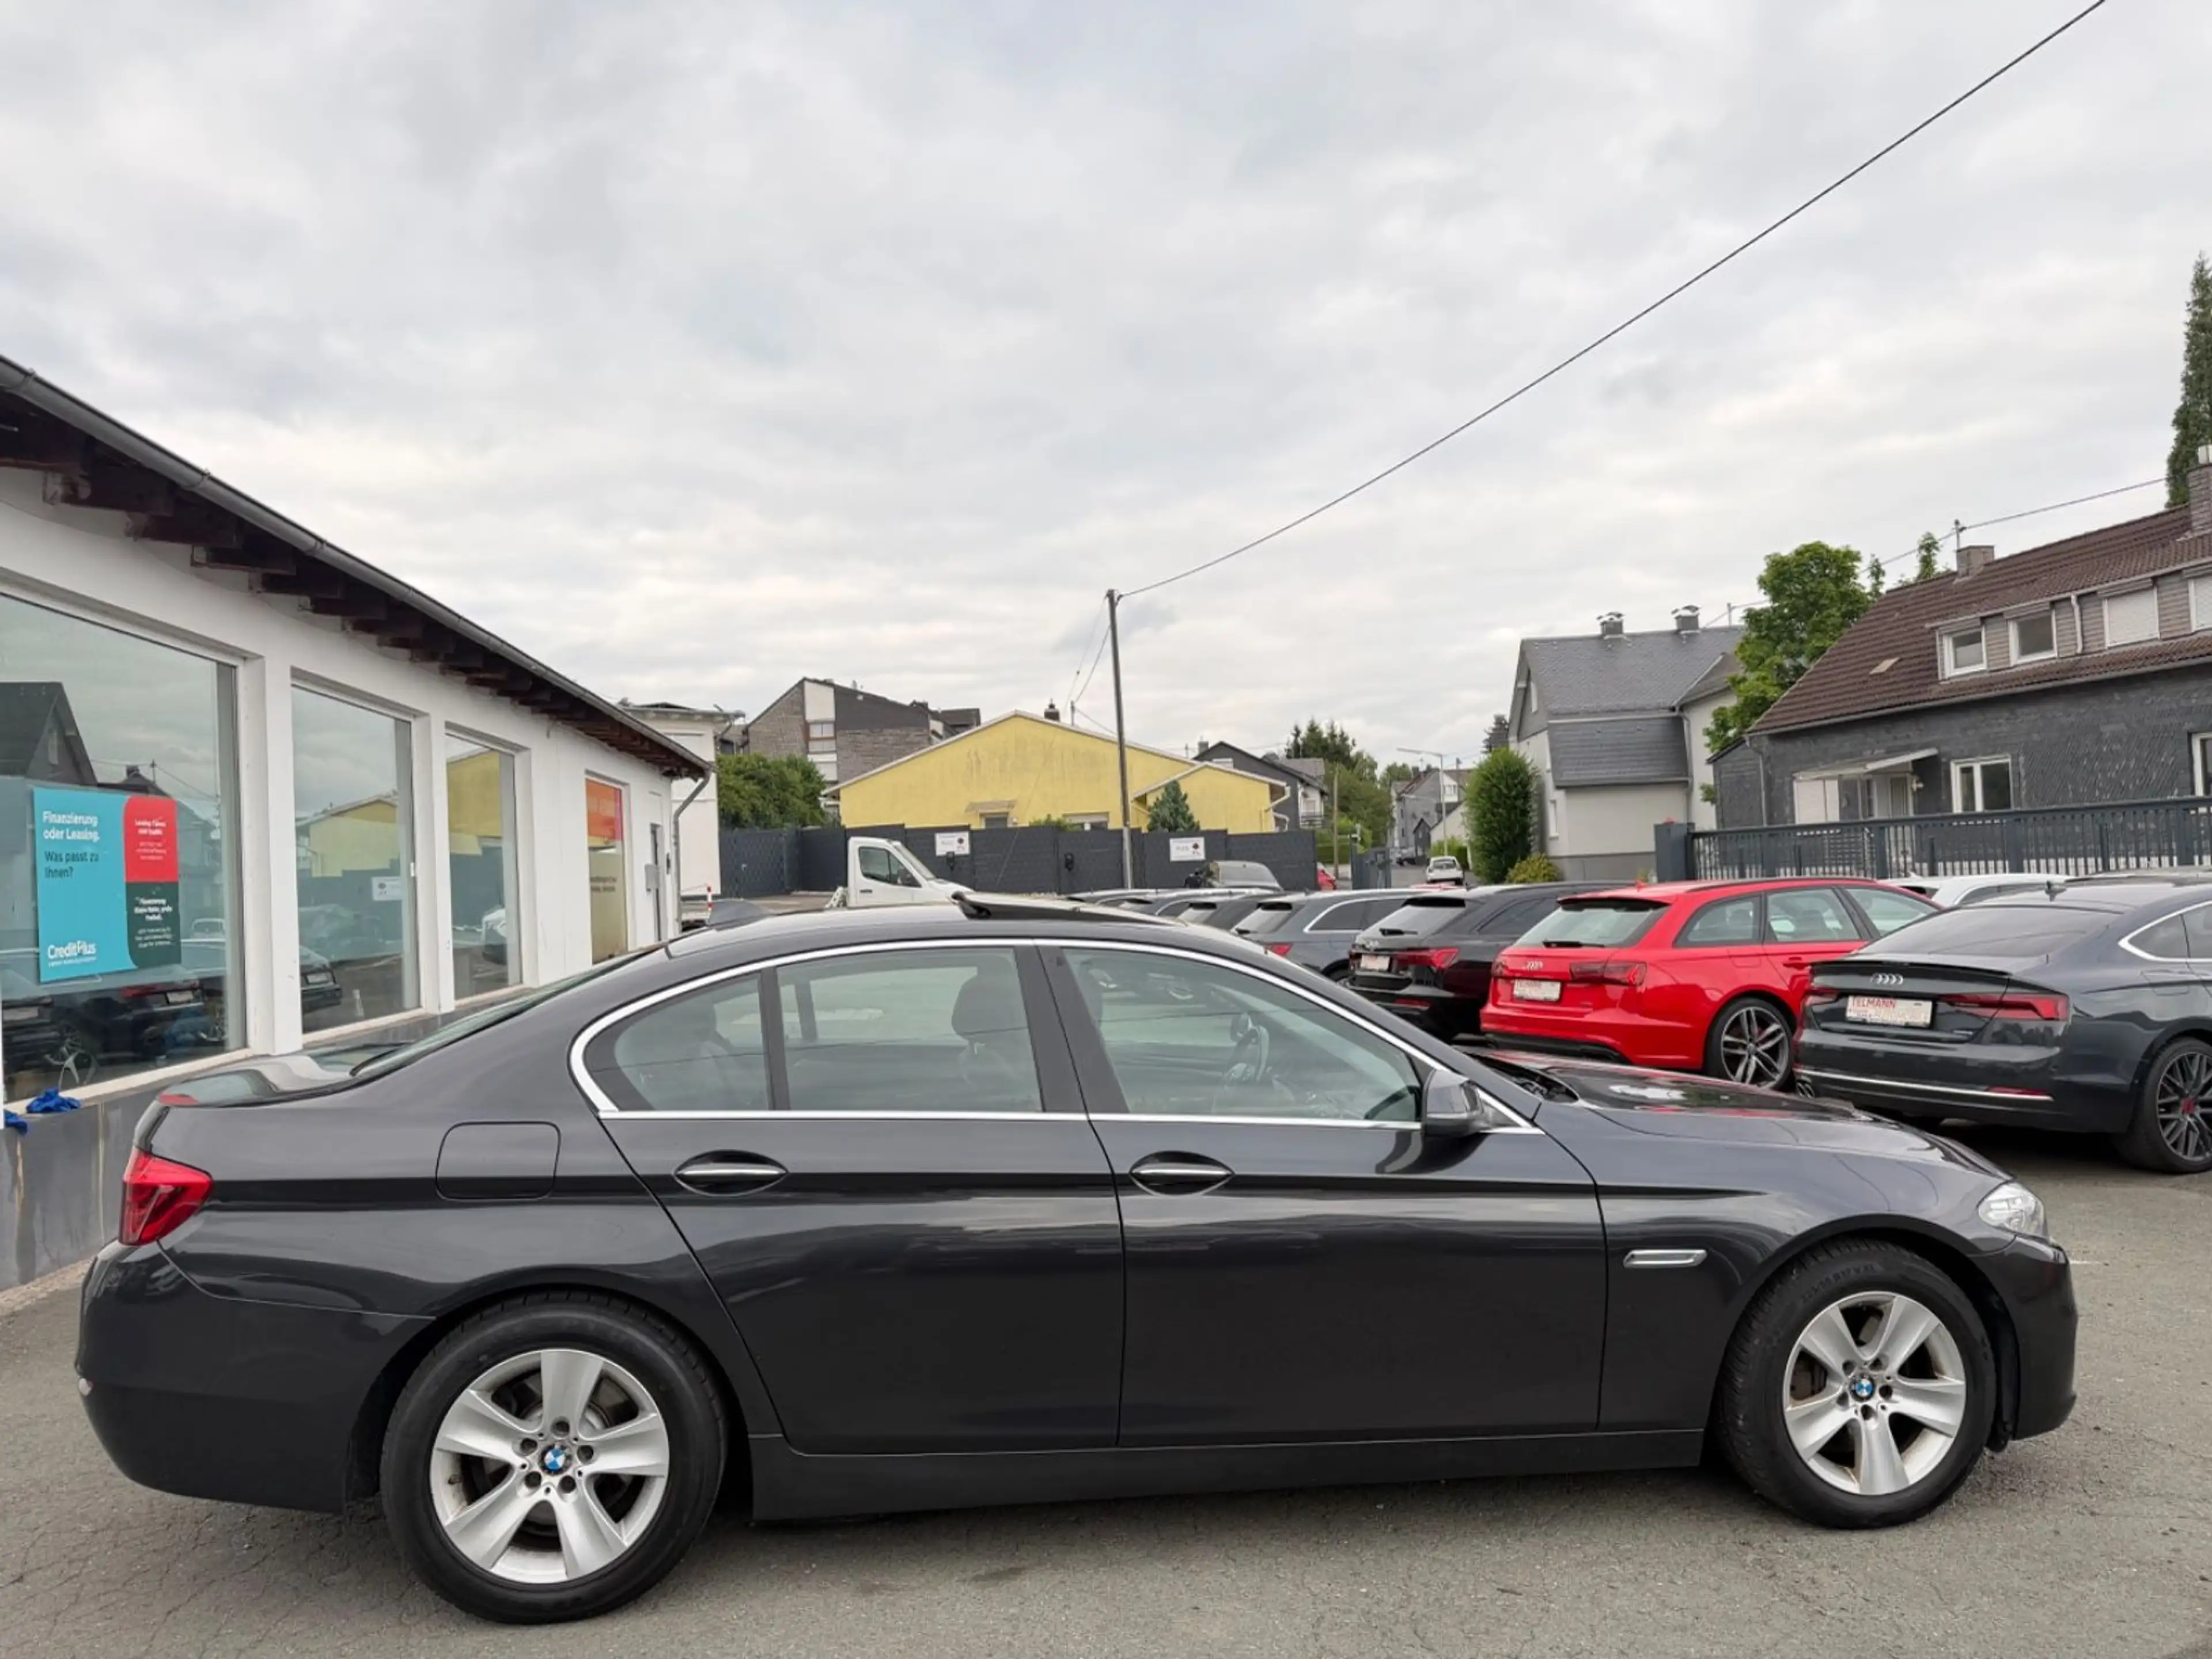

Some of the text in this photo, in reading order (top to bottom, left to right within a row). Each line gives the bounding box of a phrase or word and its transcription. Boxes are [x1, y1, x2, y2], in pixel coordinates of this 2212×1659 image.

[43, 810, 98, 827] Finanzierung
[43, 827, 100, 843] oder Leasing.
[44, 851, 99, 864] Was passt zu
[44, 865, 73, 878] Ihnen?
